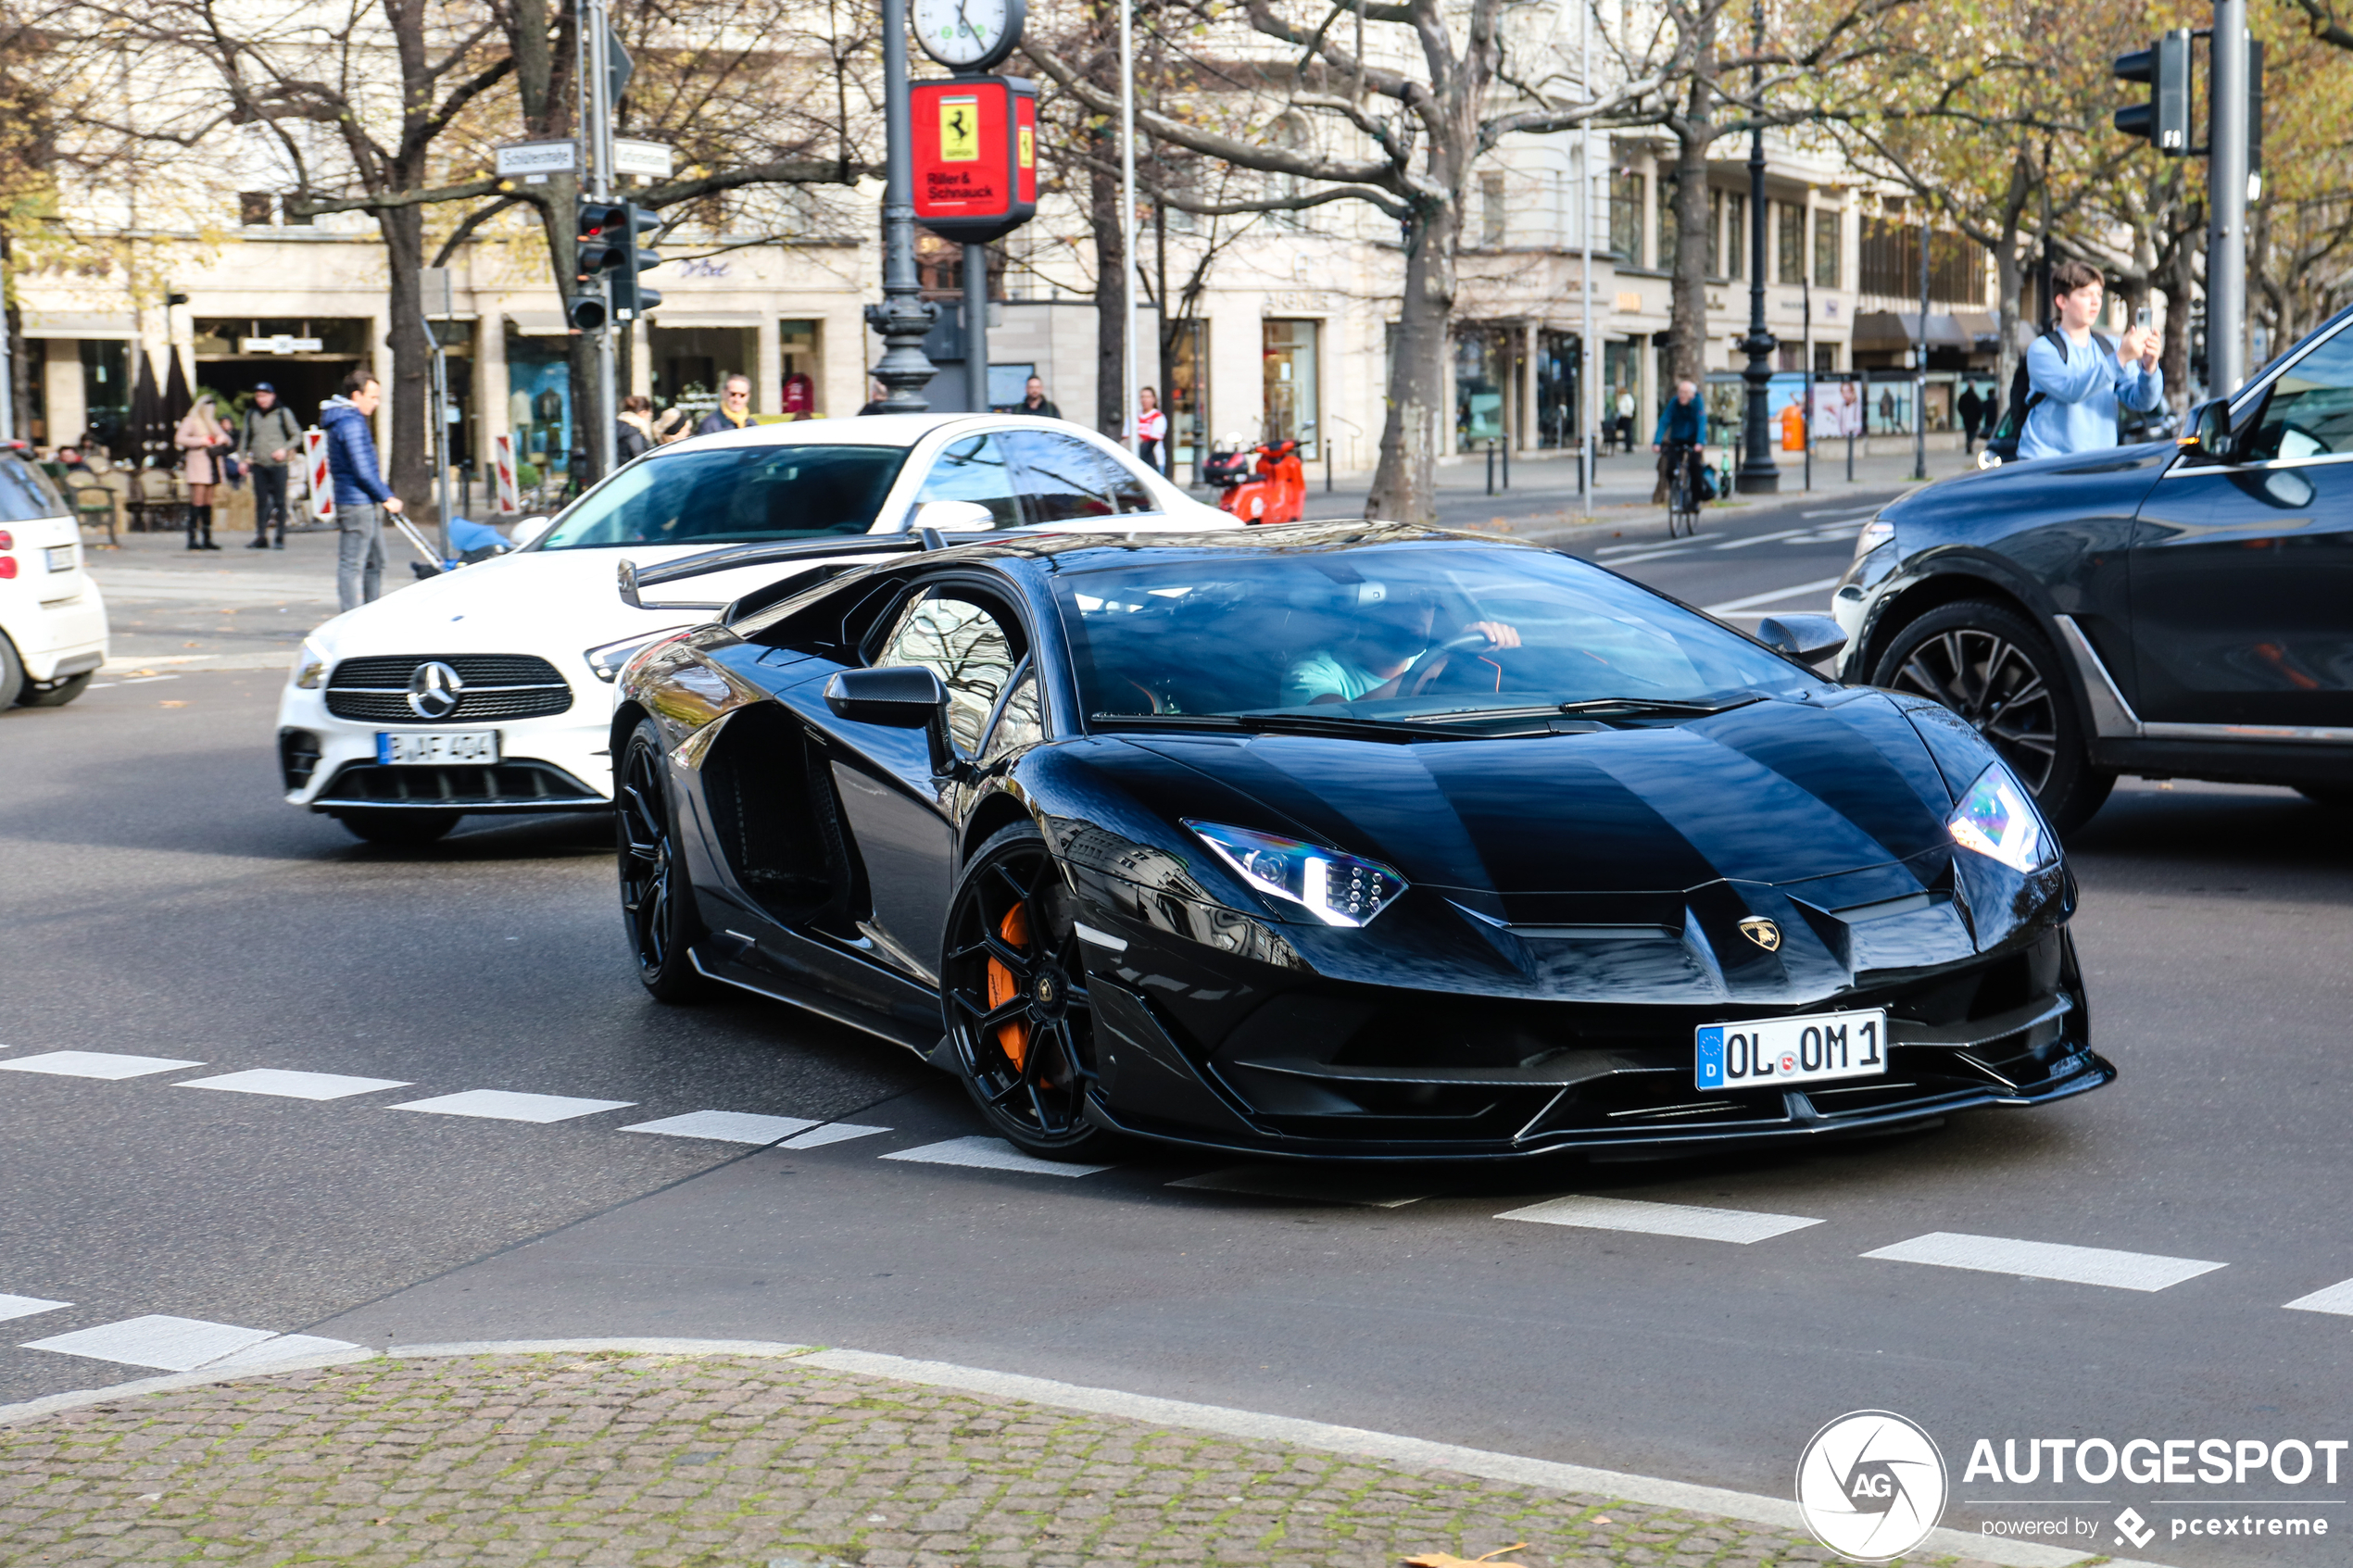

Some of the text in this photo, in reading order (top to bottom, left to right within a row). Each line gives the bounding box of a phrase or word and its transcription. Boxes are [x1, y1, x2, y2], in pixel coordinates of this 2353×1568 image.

[927, 171, 971, 185] Riller &
[927, 185, 993, 200] Schnauck
[1705, 1021, 1881, 1079] D OL OM 1
